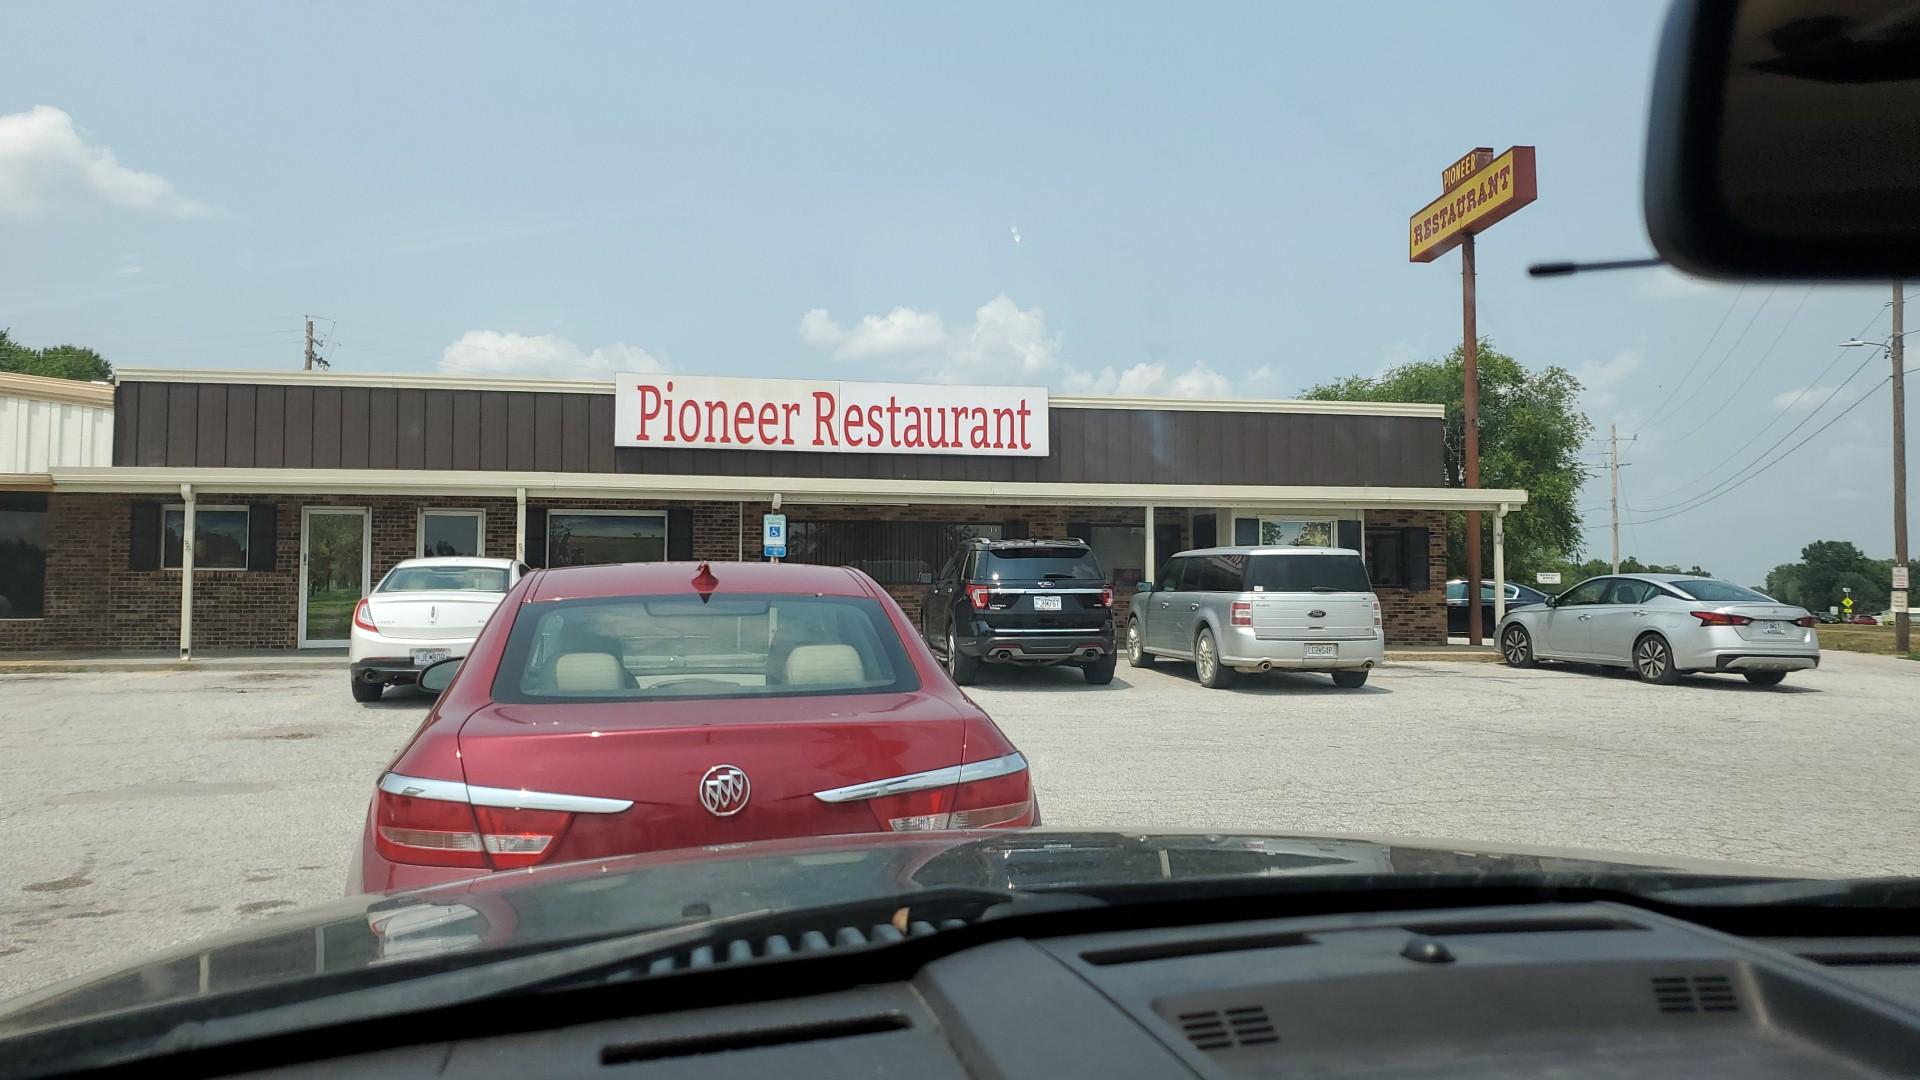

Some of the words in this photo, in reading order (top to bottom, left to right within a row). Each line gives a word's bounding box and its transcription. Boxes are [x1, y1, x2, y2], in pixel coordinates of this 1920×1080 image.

[1413, 164, 1511, 247] RESTAURANT
[1443, 153, 1476, 190] PIONEER
[636, 382, 801, 446] Pioneer
[811, 390, 1031, 450] Restaurant
